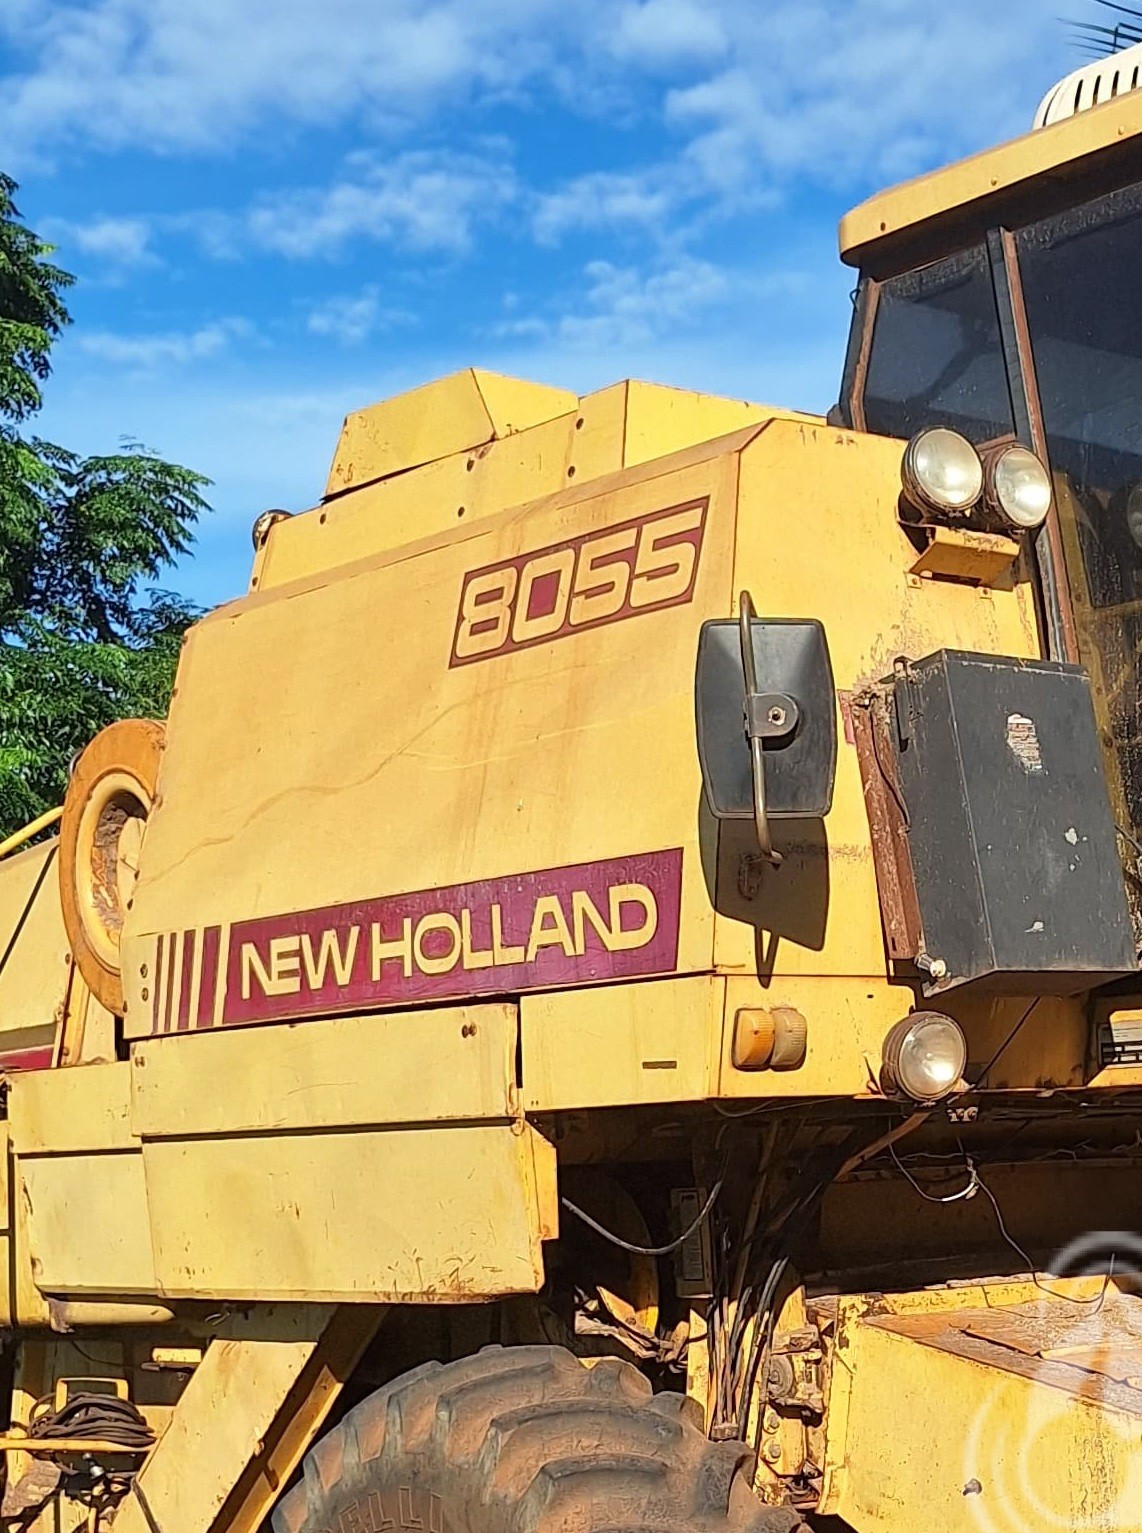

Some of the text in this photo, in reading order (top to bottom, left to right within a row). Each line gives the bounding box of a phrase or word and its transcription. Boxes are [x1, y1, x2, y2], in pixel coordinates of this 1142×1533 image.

[455, 506, 704, 659] 8055
[241, 883, 658, 999] NEW HOLLAND
